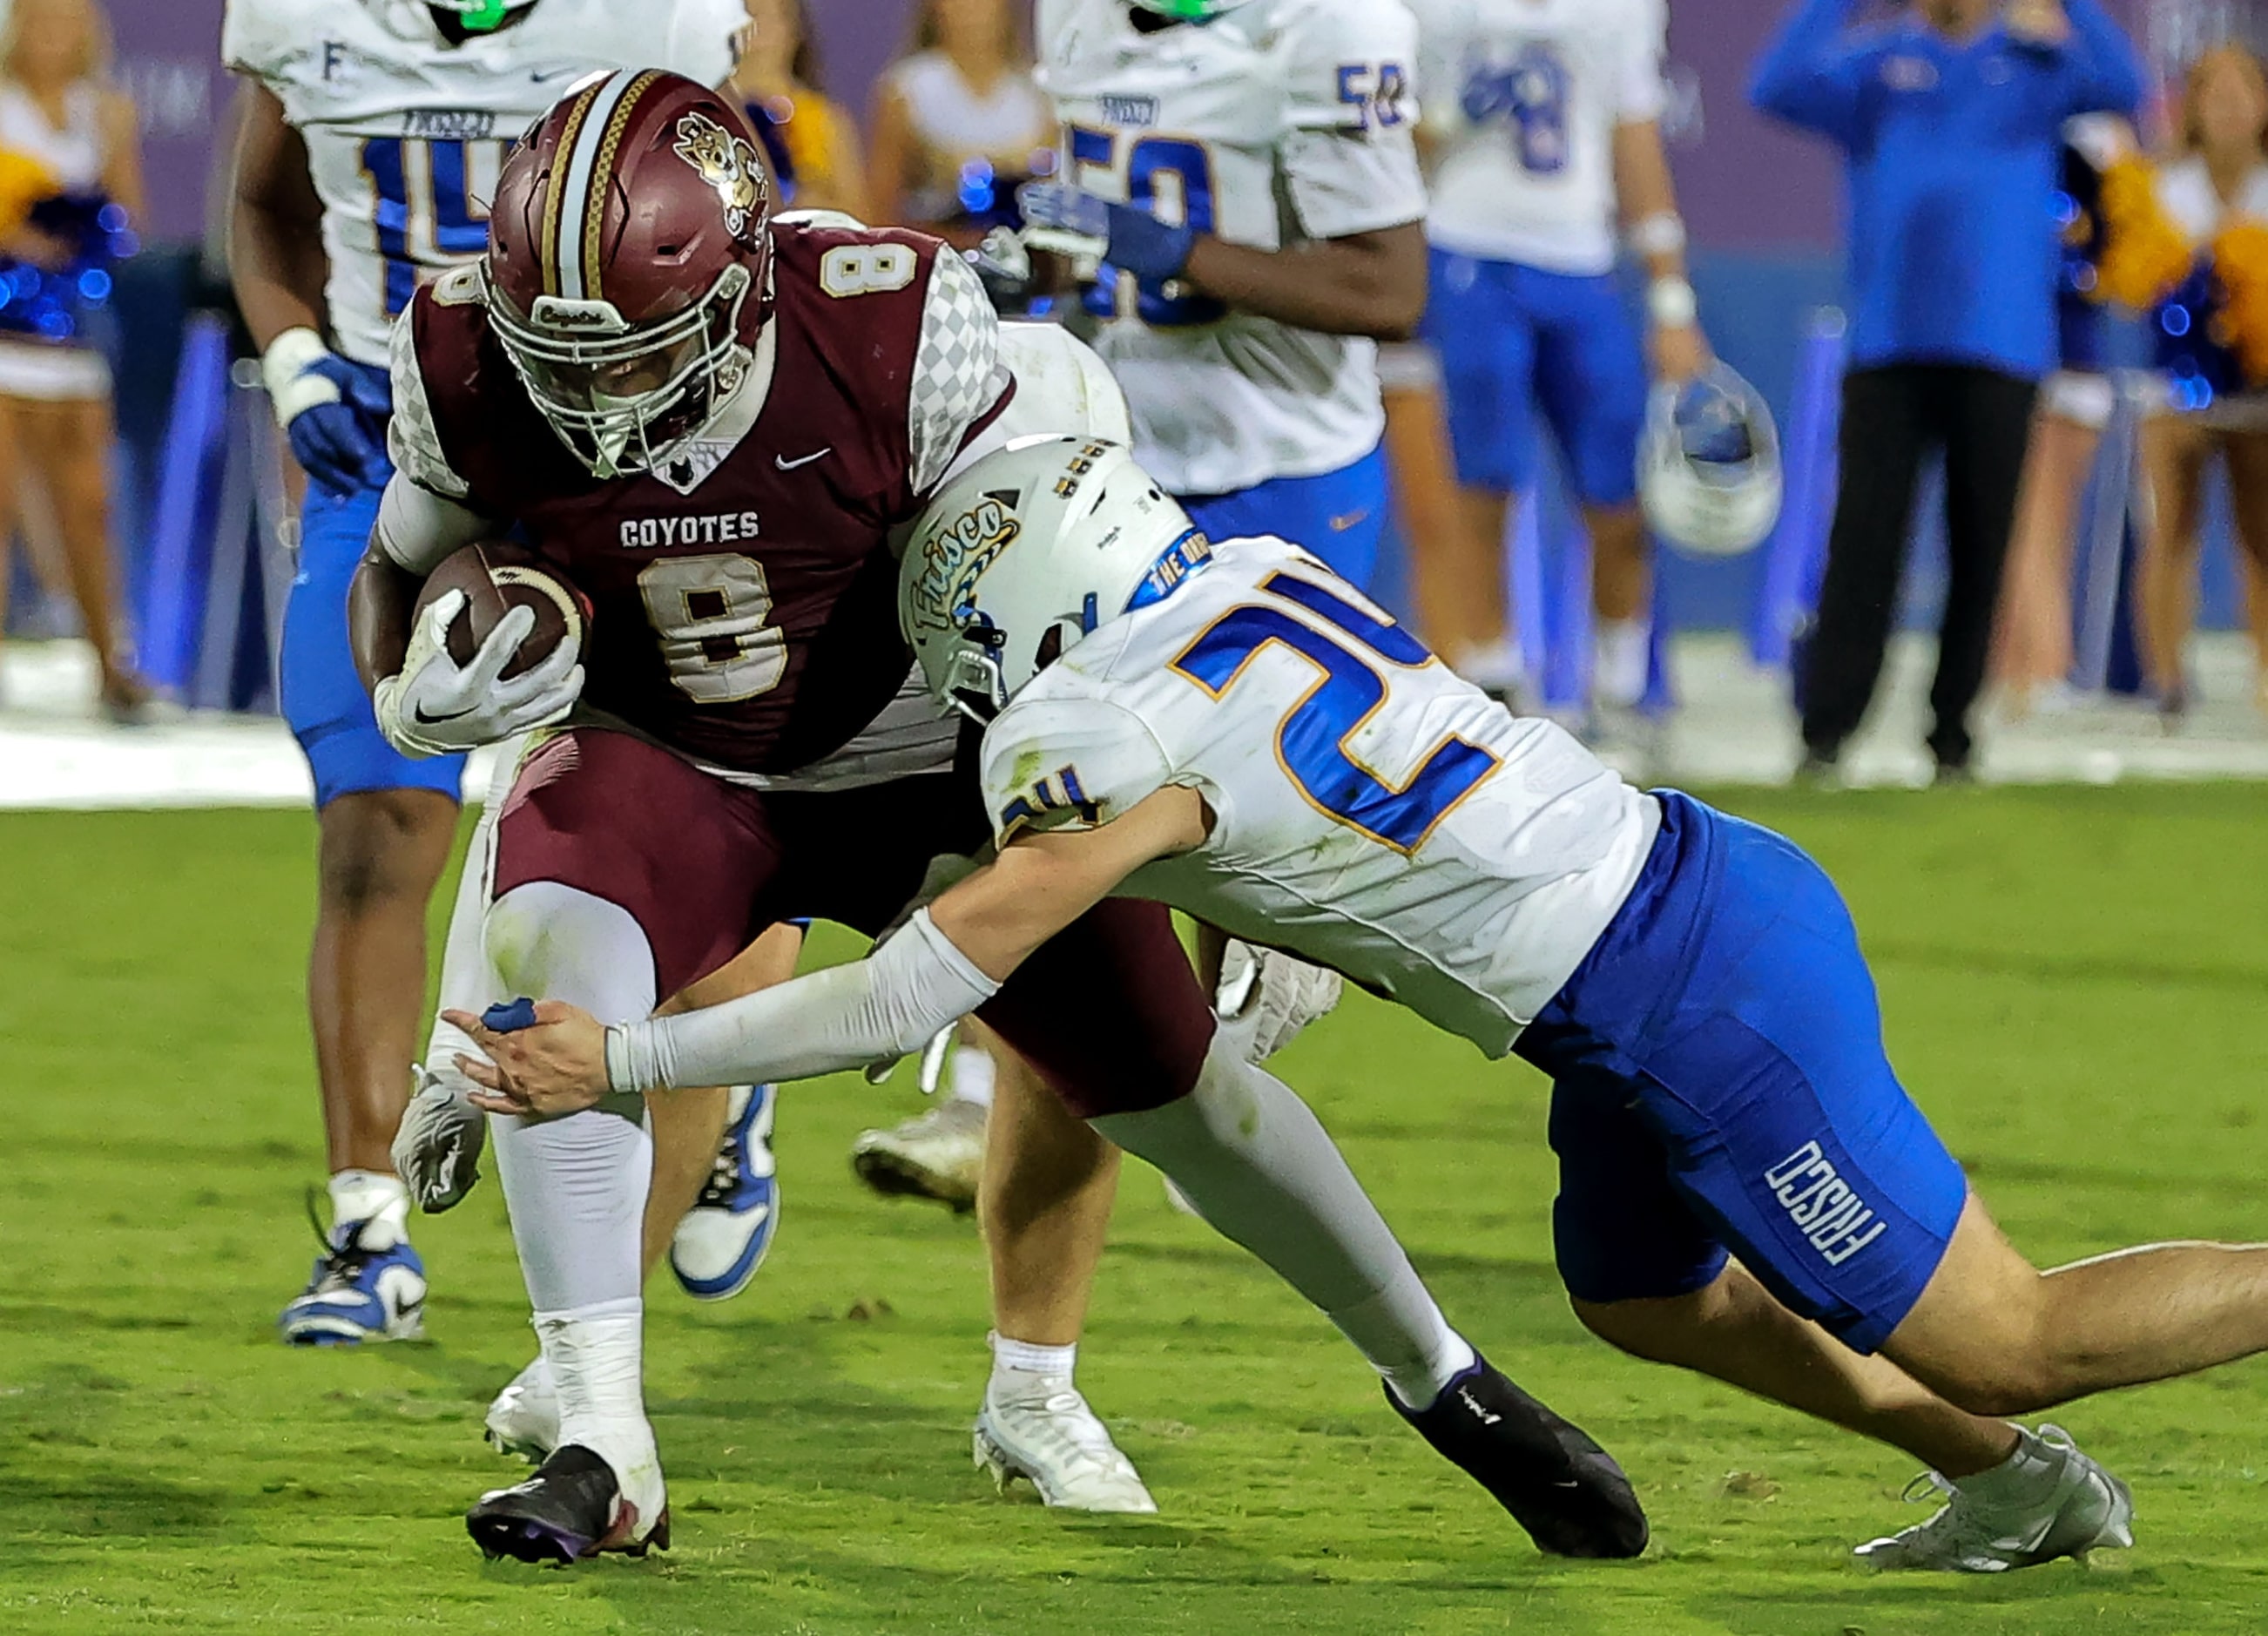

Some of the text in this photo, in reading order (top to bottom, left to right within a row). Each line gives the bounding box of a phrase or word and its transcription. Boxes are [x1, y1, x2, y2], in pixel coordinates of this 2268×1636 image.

[820, 243, 918, 298] 8
[620, 510, 759, 548] COYOTES
[910, 500, 1004, 631] Frisco
[1148, 551, 1186, 597] THE
[637, 552, 788, 704] 8
[1764, 1139, 1887, 1267] FRISCO
